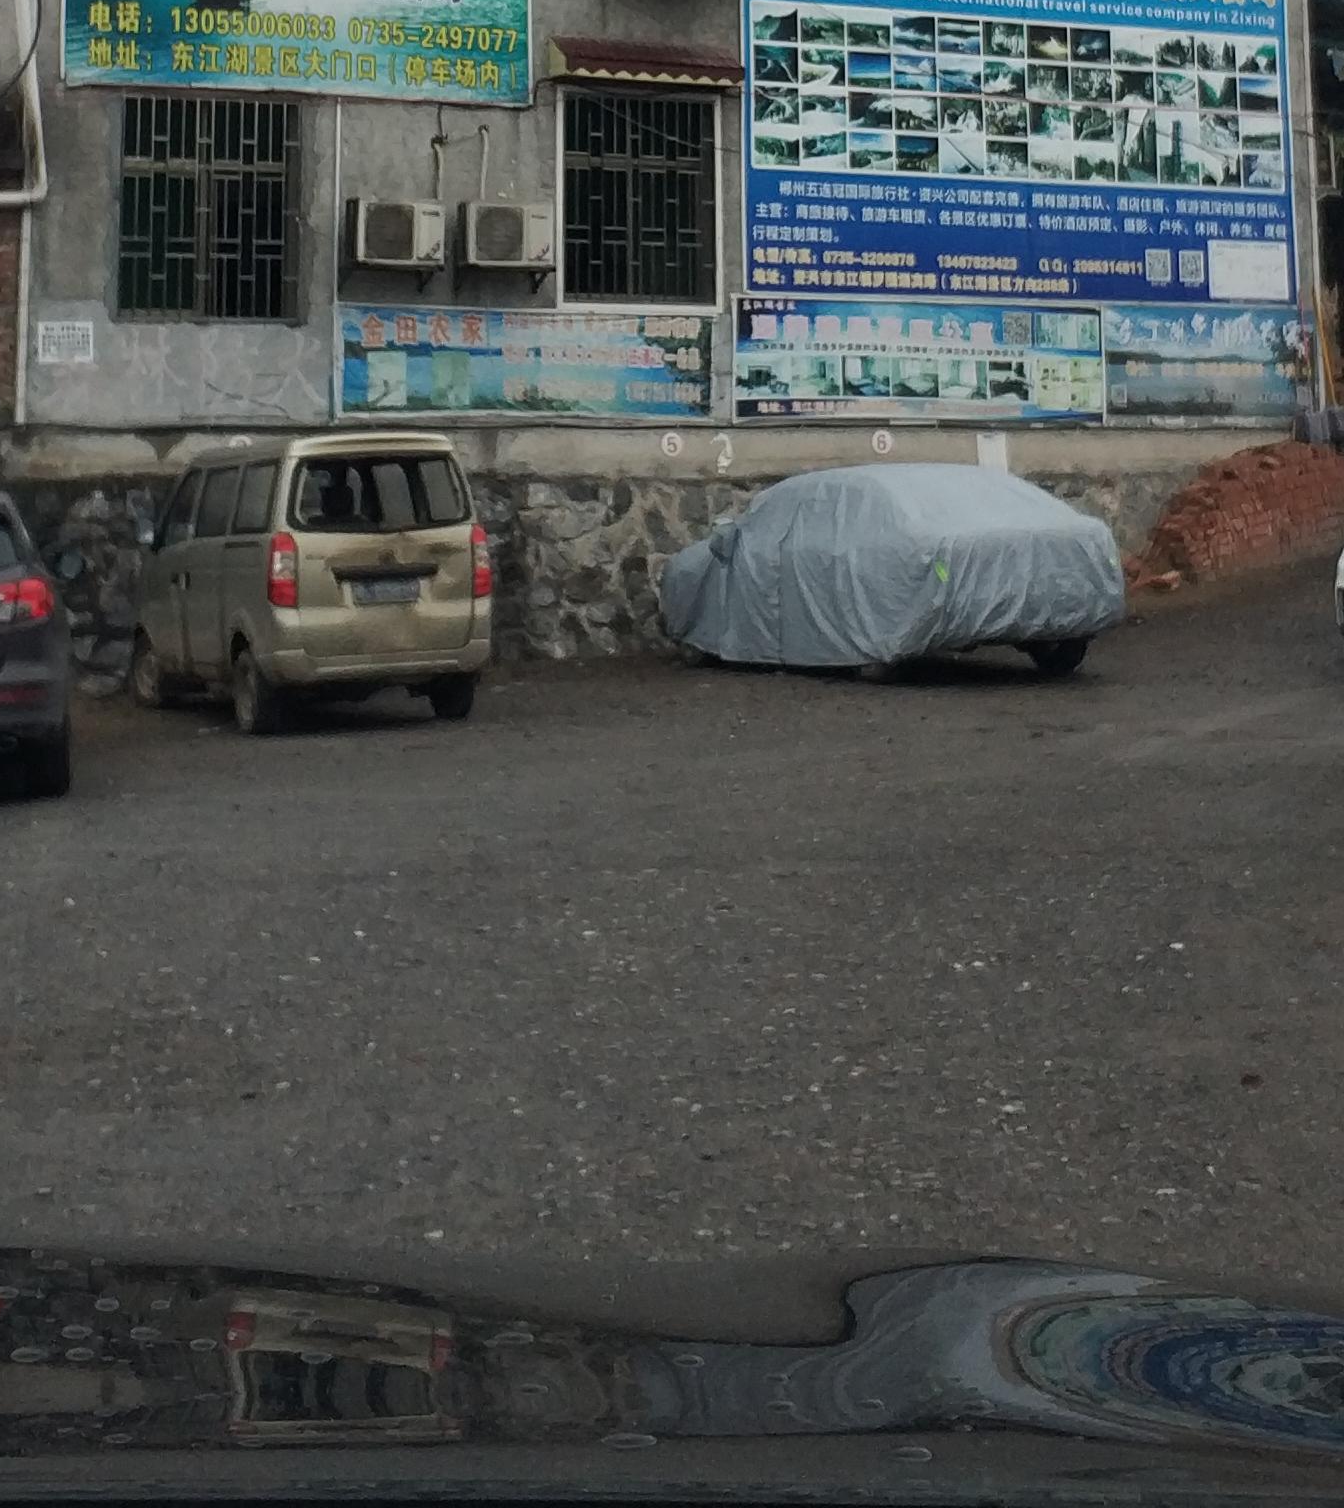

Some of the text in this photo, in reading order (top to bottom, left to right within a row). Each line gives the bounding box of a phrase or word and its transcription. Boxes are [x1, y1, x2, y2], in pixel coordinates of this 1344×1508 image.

[1089, 2, 1143, 18] service
[1146, 7, 1211, 25] company
[1214, 10, 1228, 24] in
[1230, 9, 1275, 29] Zixing
[347, 16, 519, 53] 0735-2497077
